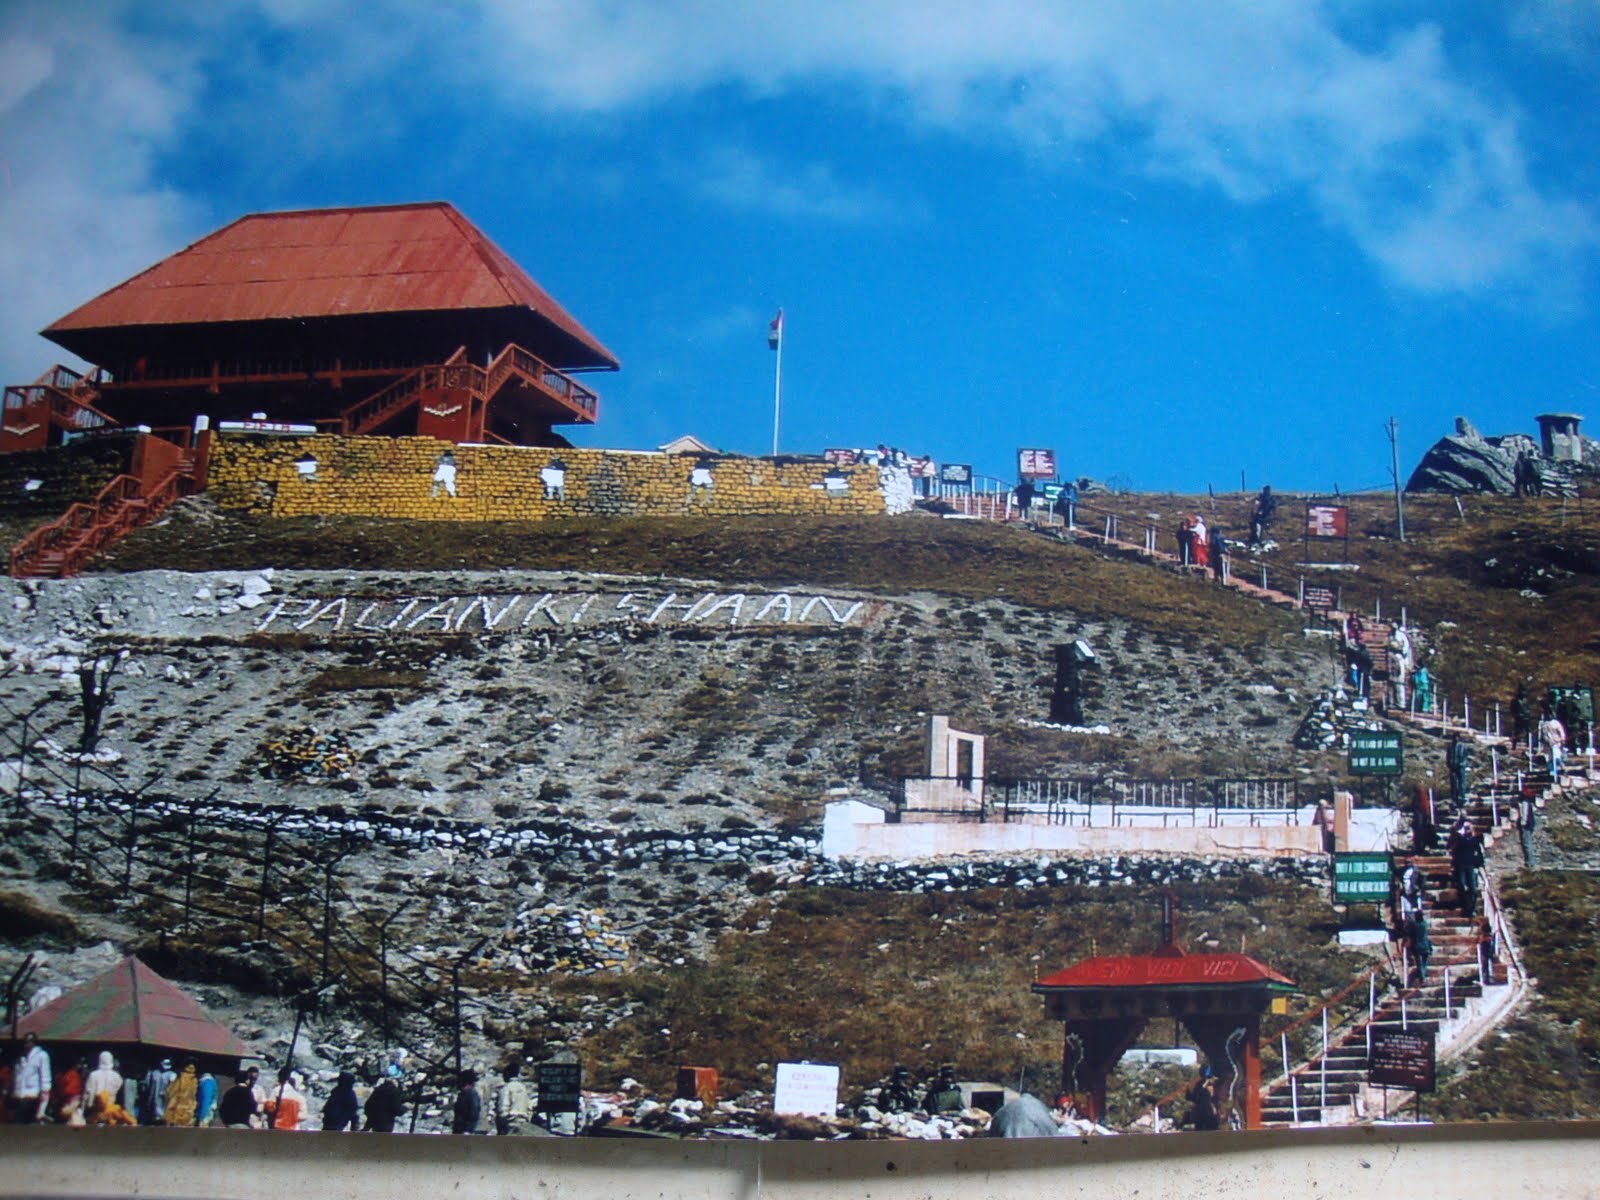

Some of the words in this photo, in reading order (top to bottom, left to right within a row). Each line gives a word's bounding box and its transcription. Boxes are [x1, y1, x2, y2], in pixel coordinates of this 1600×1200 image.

[522, 593, 598, 626] KI
[616, 592, 863, 626] SHAAN
[1203, 960, 1240, 976] VICI
